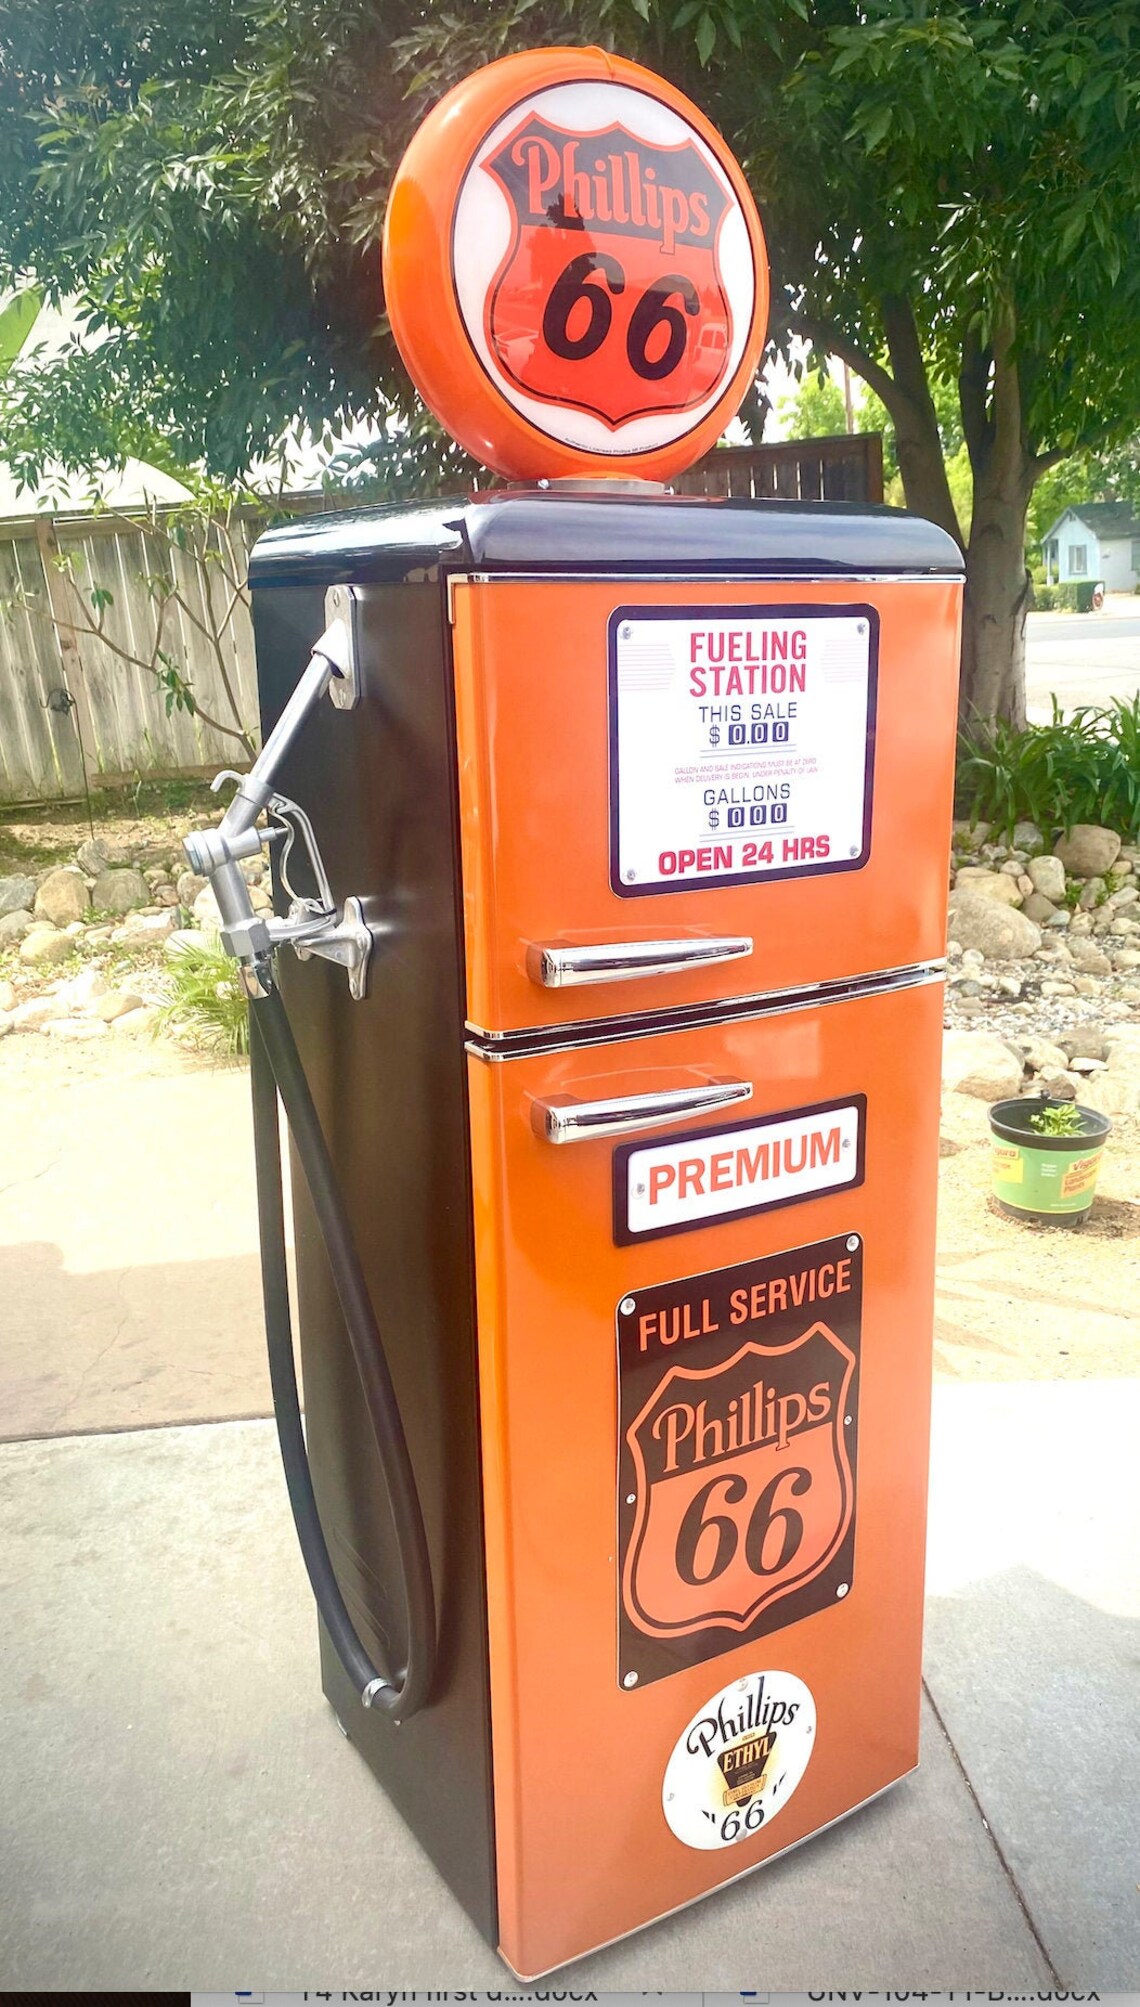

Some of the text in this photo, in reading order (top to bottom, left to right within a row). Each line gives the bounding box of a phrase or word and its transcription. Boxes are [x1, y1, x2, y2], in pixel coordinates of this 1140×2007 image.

[511, 135, 711, 255] Phillips
[542, 251, 701, 381] 66
[689, 630, 807, 663] FUELING
[689, 663, 806, 697] STATION
[698, 701, 798, 723] THIS SALE
[703, 782, 791, 806] GALLONS
[658, 834, 830, 875] OPEN 24 HRS
[649, 1126, 841, 1206] PREMIUM
[638, 1257, 852, 1352] FULL SERVICE
[651, 1380, 832, 1473] Phillips
[674, 1465, 814, 1587] 66
[686, 1675, 802, 1758] Phillips
[722, 1735, 771, 1774] ETHYL
